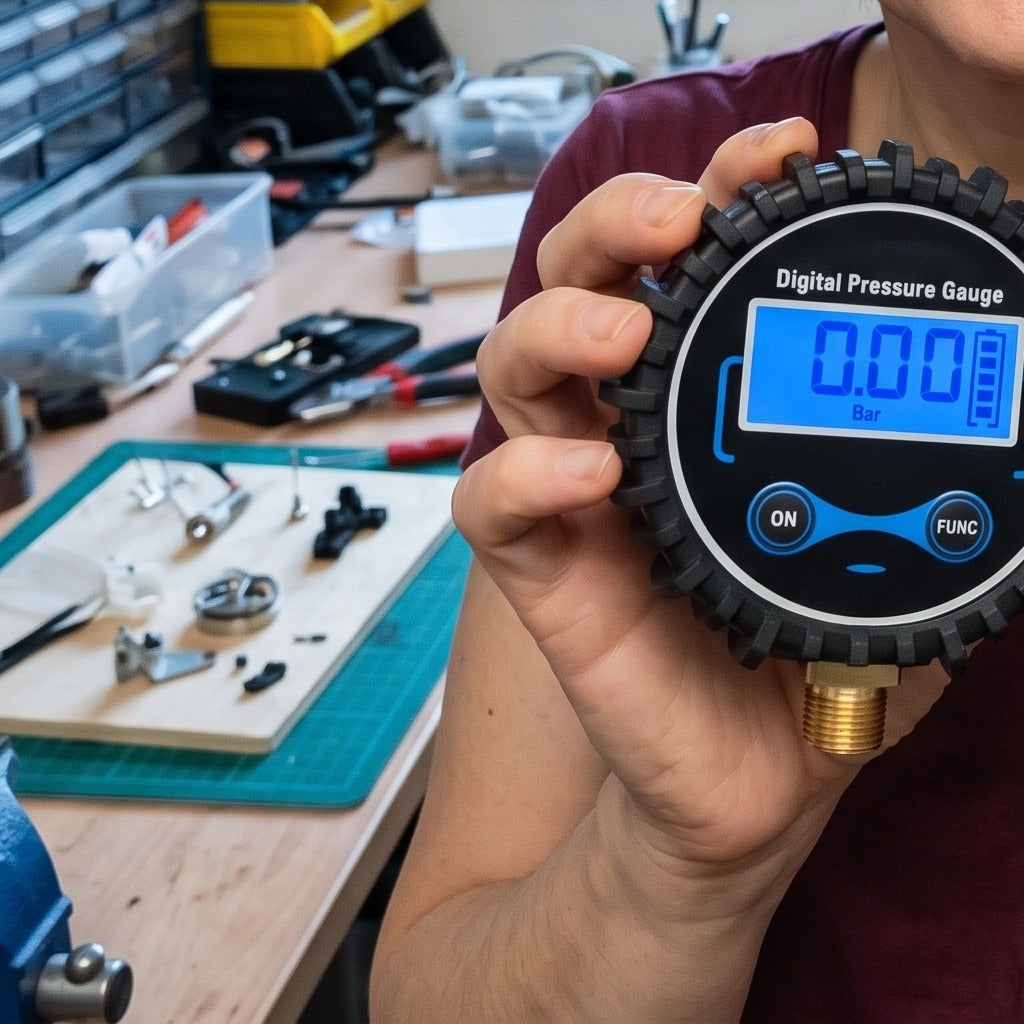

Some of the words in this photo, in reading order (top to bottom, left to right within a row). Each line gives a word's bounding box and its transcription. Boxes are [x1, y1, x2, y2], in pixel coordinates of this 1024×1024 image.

[776, 268, 842, 295] Digital
[847, 273, 936, 299] Pressure
[942, 280, 1004, 307] Gauge
[810, 320, 966, 404] 0.00
[851, 404, 881, 422] Bar
[770, 510, 797, 527] ON
[936, 519, 978, 536] FUNC
